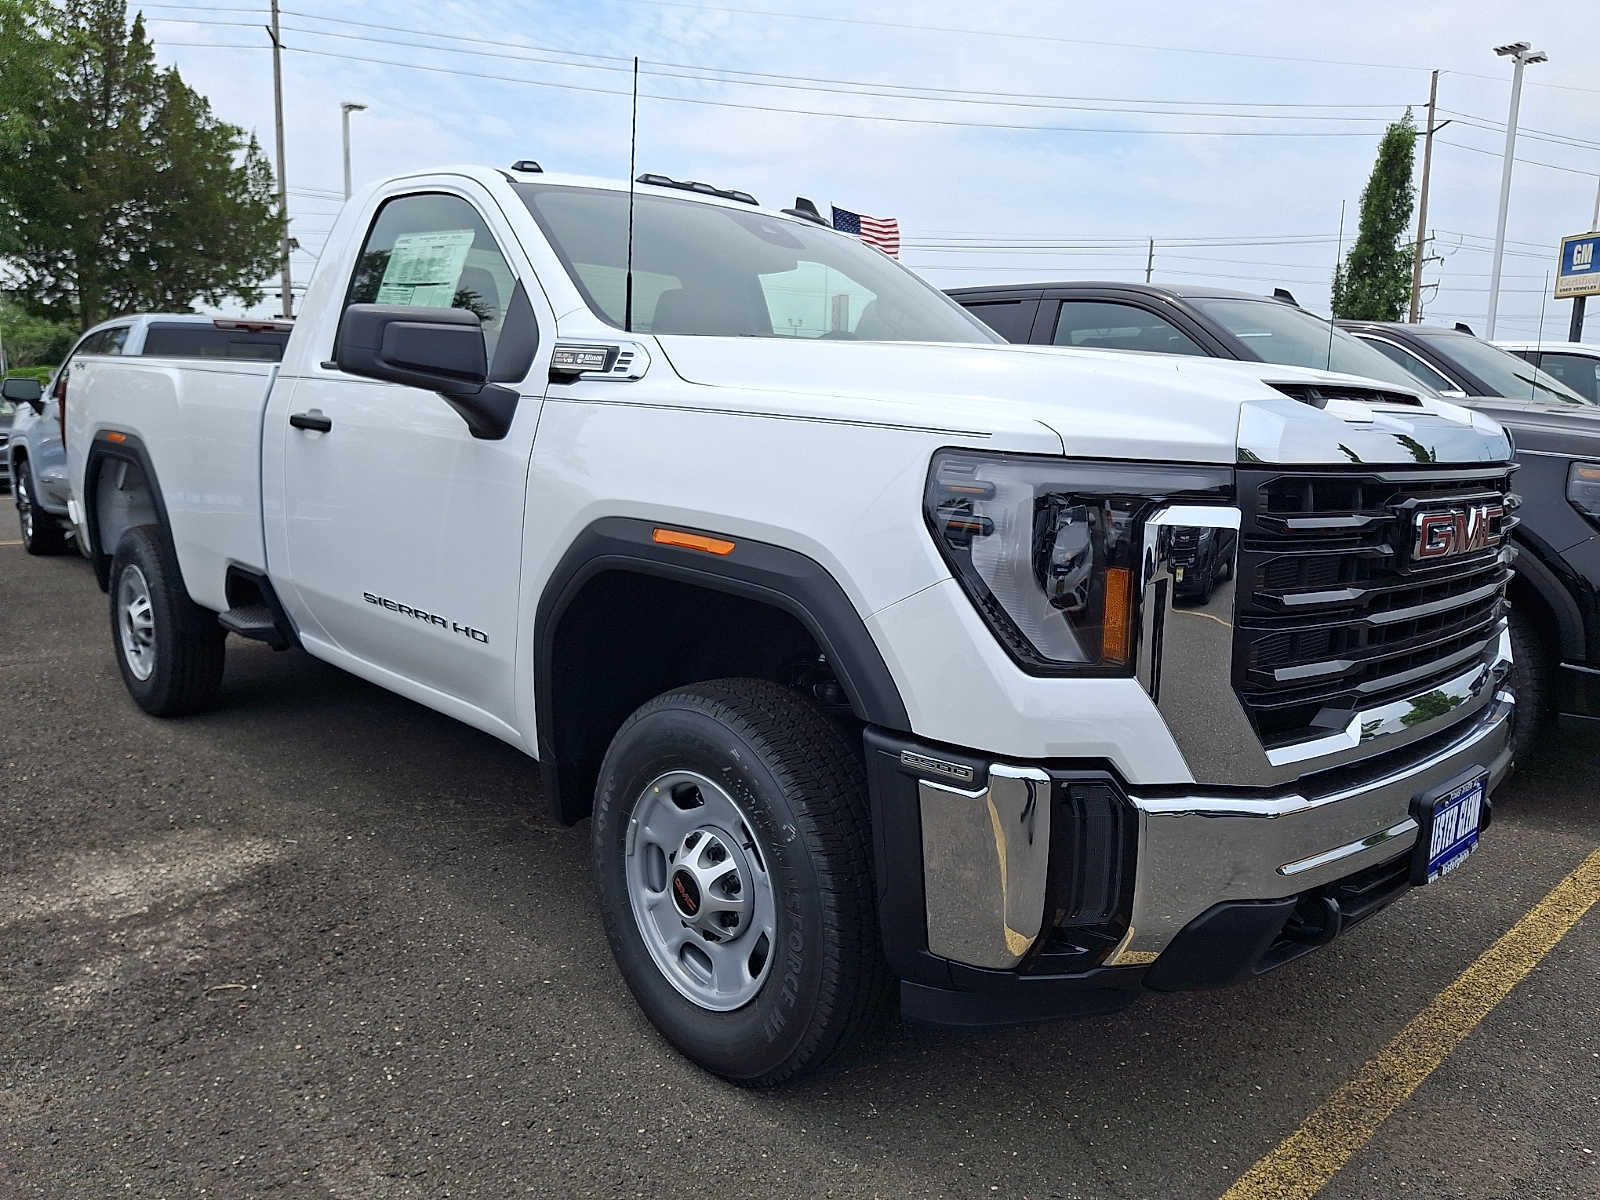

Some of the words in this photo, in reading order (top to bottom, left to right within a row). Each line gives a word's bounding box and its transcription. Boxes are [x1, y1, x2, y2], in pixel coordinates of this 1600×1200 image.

[1573, 242, 1594, 266] GM
[1413, 505, 1504, 560] GMC
[363, 591, 448, 629] SIERRA
[452, 621, 489, 644] HD
[675, 876, 697, 911] GMC
